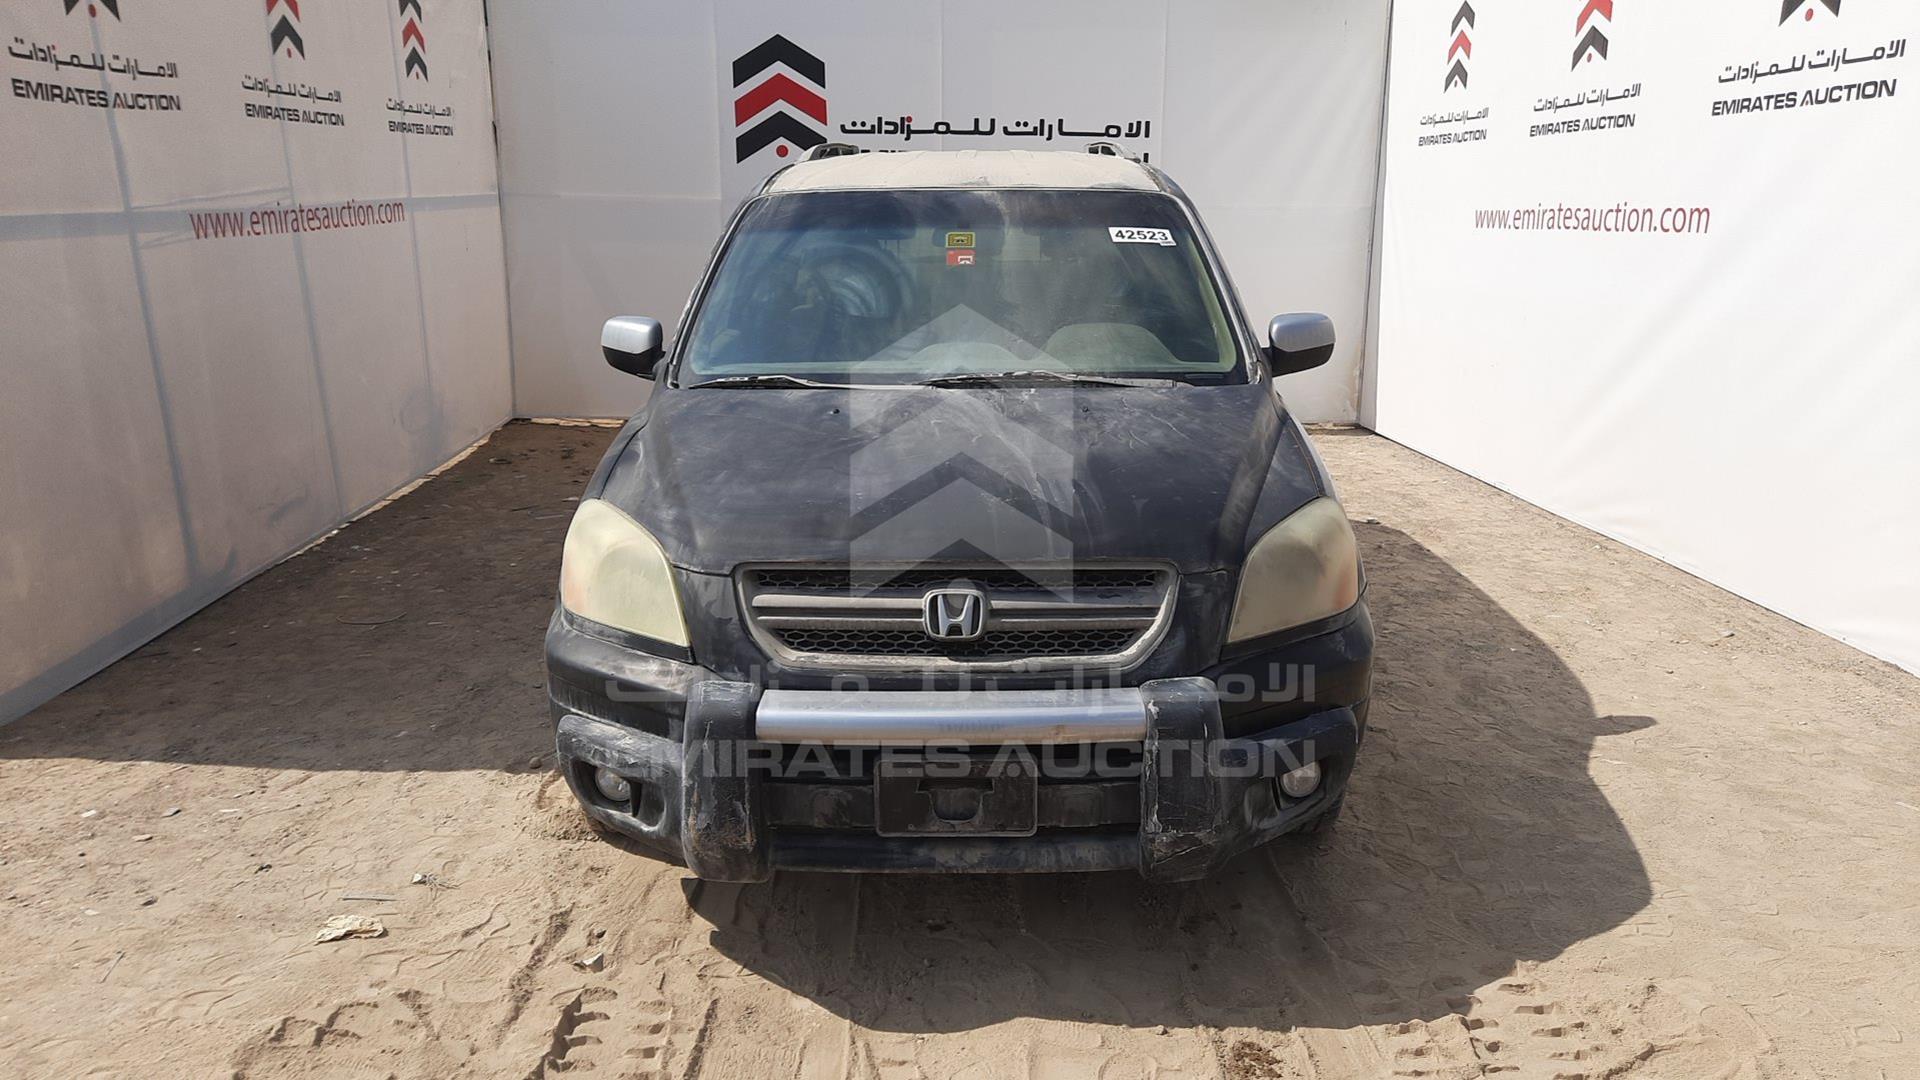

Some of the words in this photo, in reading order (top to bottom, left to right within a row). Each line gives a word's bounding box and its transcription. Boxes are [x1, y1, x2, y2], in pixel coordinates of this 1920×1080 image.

[11, 78, 109, 108] EMIRATES
[112, 92, 181, 111] AUCTION
[1711, 91, 1797, 116] EMIRATES
[1800, 78, 1897, 107] AUCTION
[244, 103, 300, 122] EMIRATES
[302, 110, 345, 126] AUCTION
[1529, 118, 1580, 137] EMIRATES
[1582, 114, 1636, 132] AUCTION
[388, 121, 424, 135] EMIRATES
[426, 124, 454, 136] AUCTION
[1418, 133, 1452, 147] EMIRATES
[1452, 129, 1487, 143] AUCTION
[189, 198, 405, 240] www.emiratesauction.com
[1474, 201, 1711, 234] www.emiratesauction.com
[1115, 229, 1169, 241] 42523
